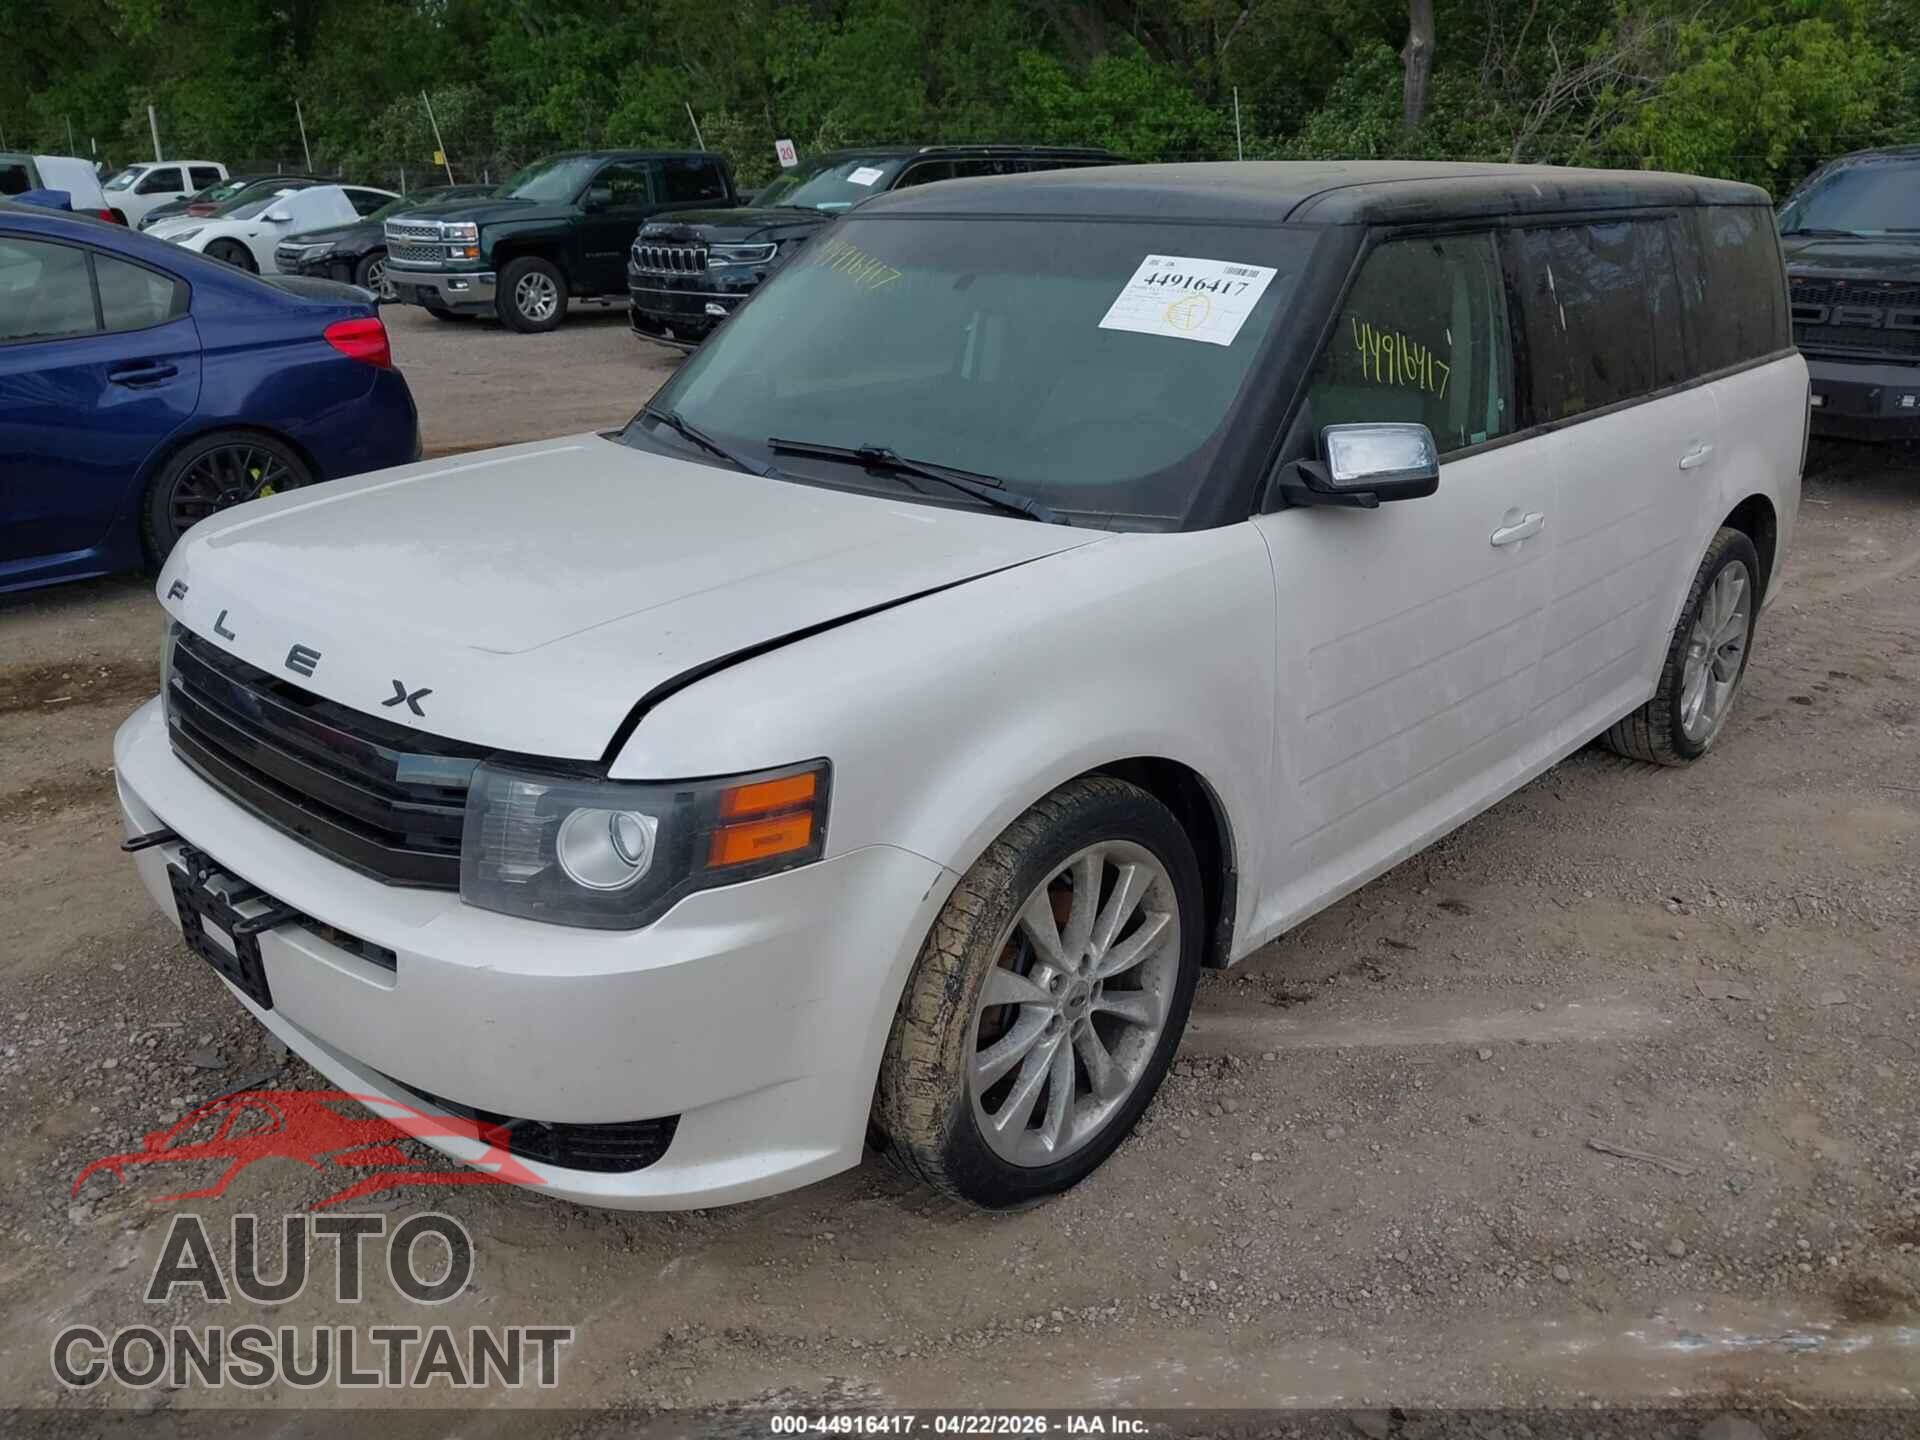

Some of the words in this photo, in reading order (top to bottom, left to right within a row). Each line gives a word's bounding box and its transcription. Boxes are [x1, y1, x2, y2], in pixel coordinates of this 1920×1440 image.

[780, 147, 793, 160] 20
[1143, 271, 1250, 297] 44916417
[1351, 317, 1450, 401] 44916417
[167, 578, 433, 718] FLEX
